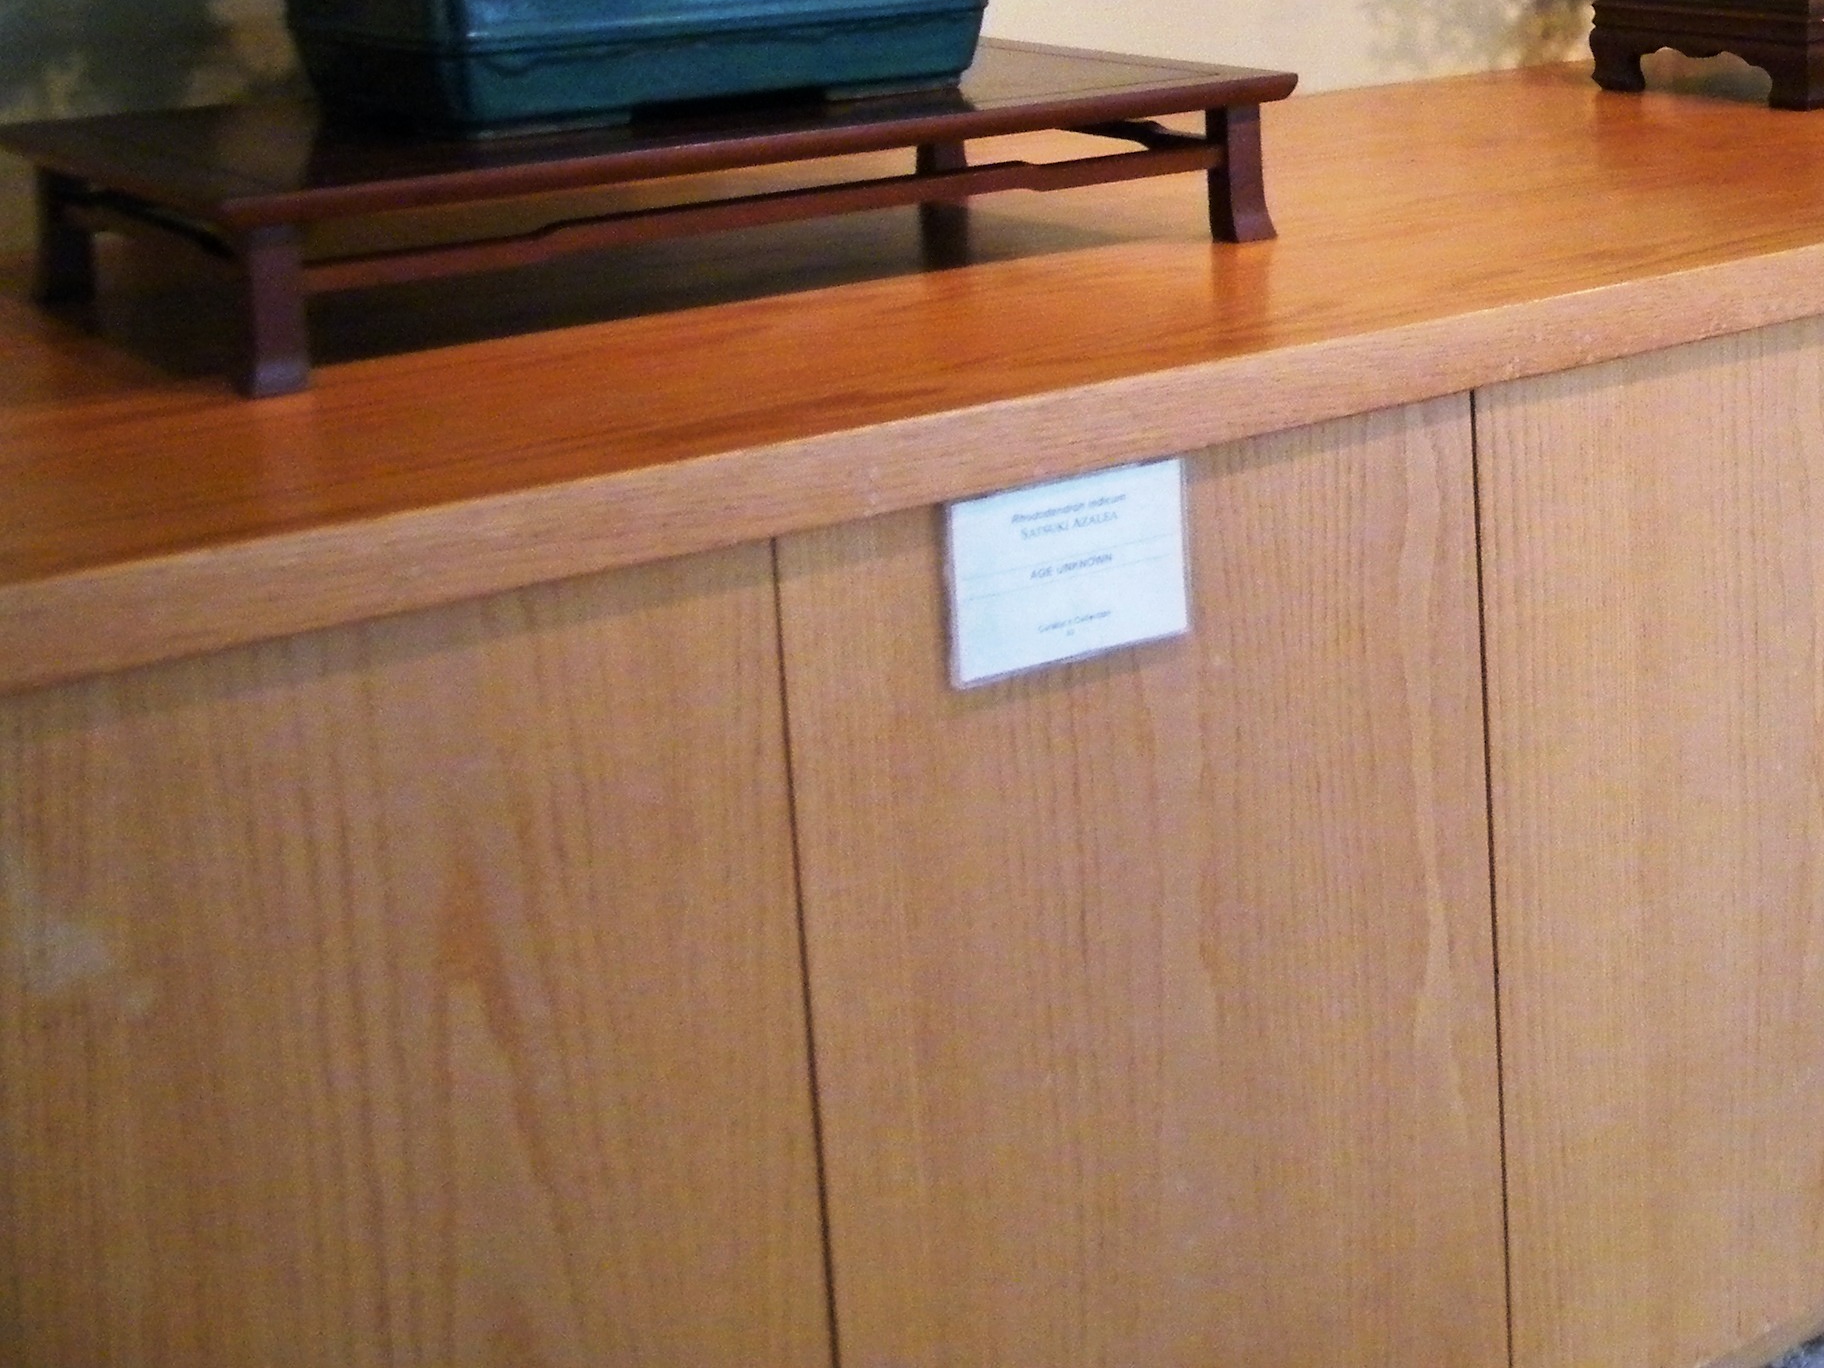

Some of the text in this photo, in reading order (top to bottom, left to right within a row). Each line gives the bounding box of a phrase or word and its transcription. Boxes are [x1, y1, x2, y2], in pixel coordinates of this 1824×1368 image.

[1072, 511, 1119, 529] AZALEA
[1030, 553, 1112, 580] AGE UNKNOWN
